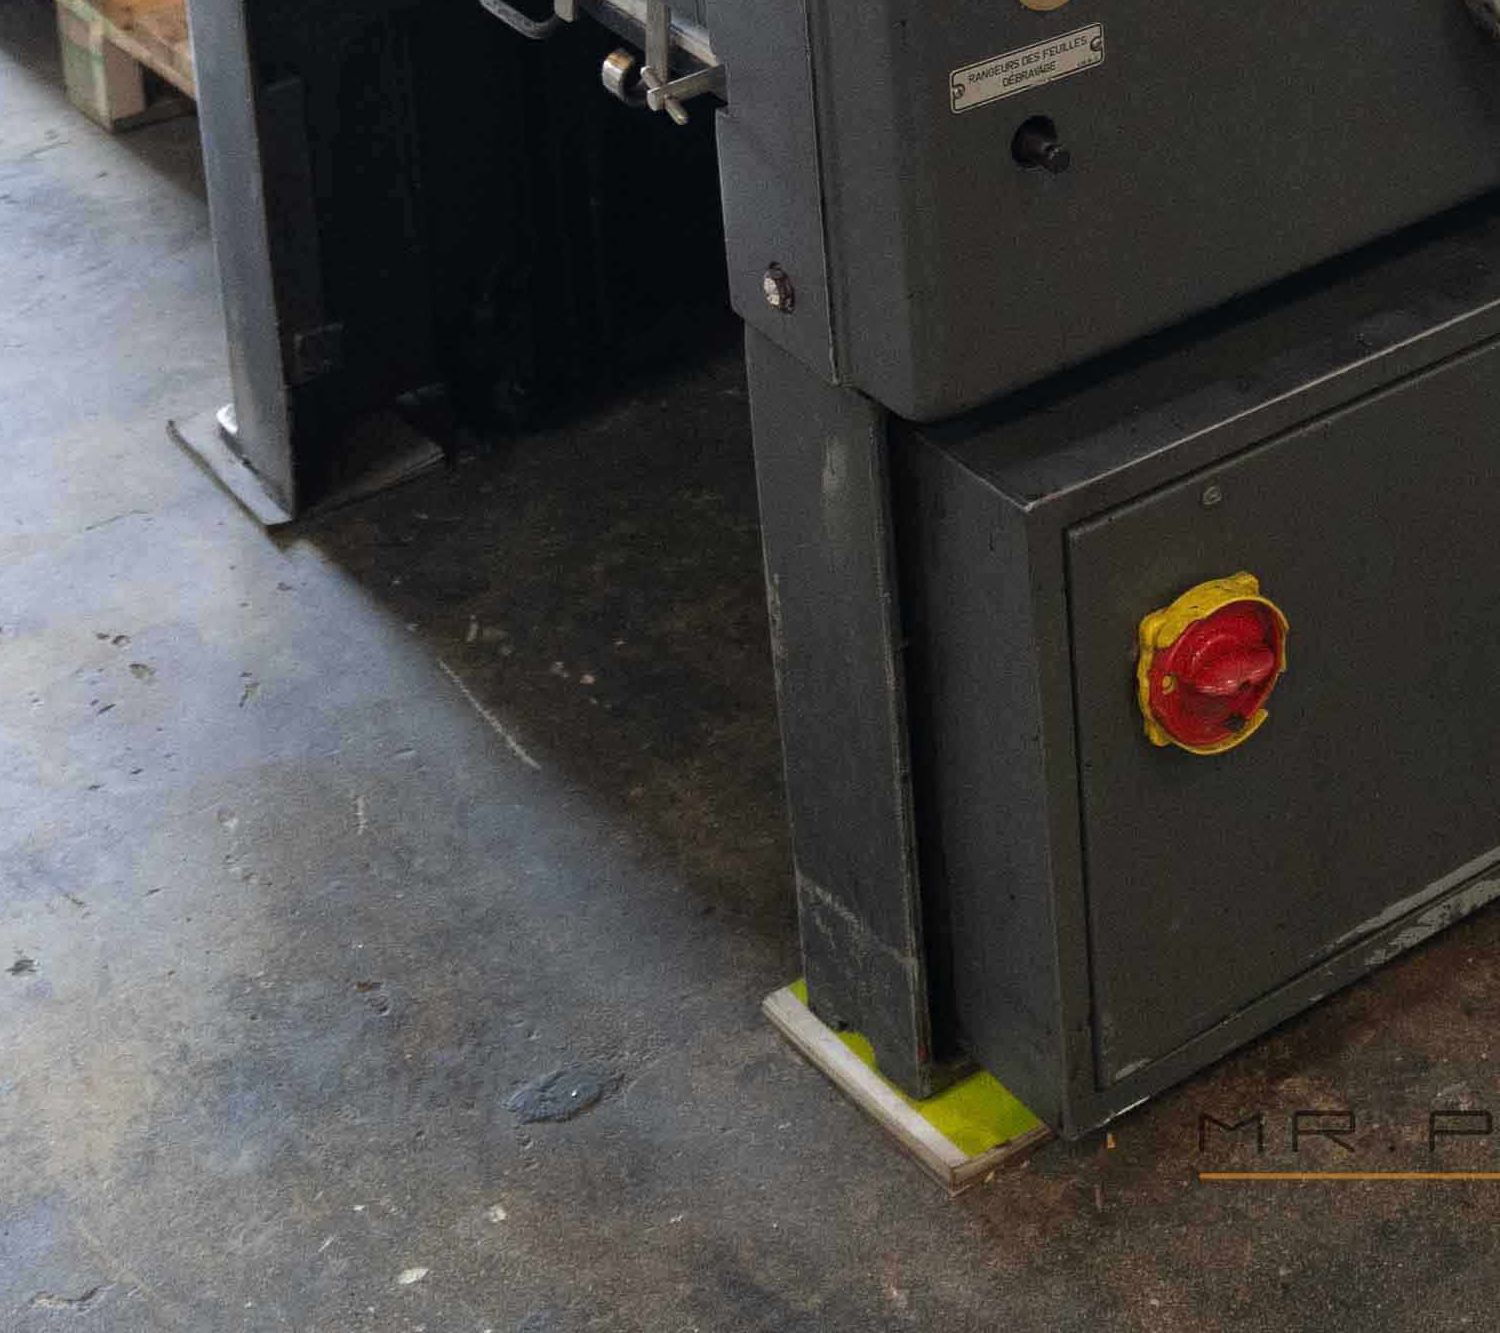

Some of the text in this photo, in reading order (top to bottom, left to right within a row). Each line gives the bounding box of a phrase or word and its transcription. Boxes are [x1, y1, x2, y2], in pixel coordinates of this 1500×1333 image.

[968, 36, 1089, 84] RANGEURS DES FEUILLES
